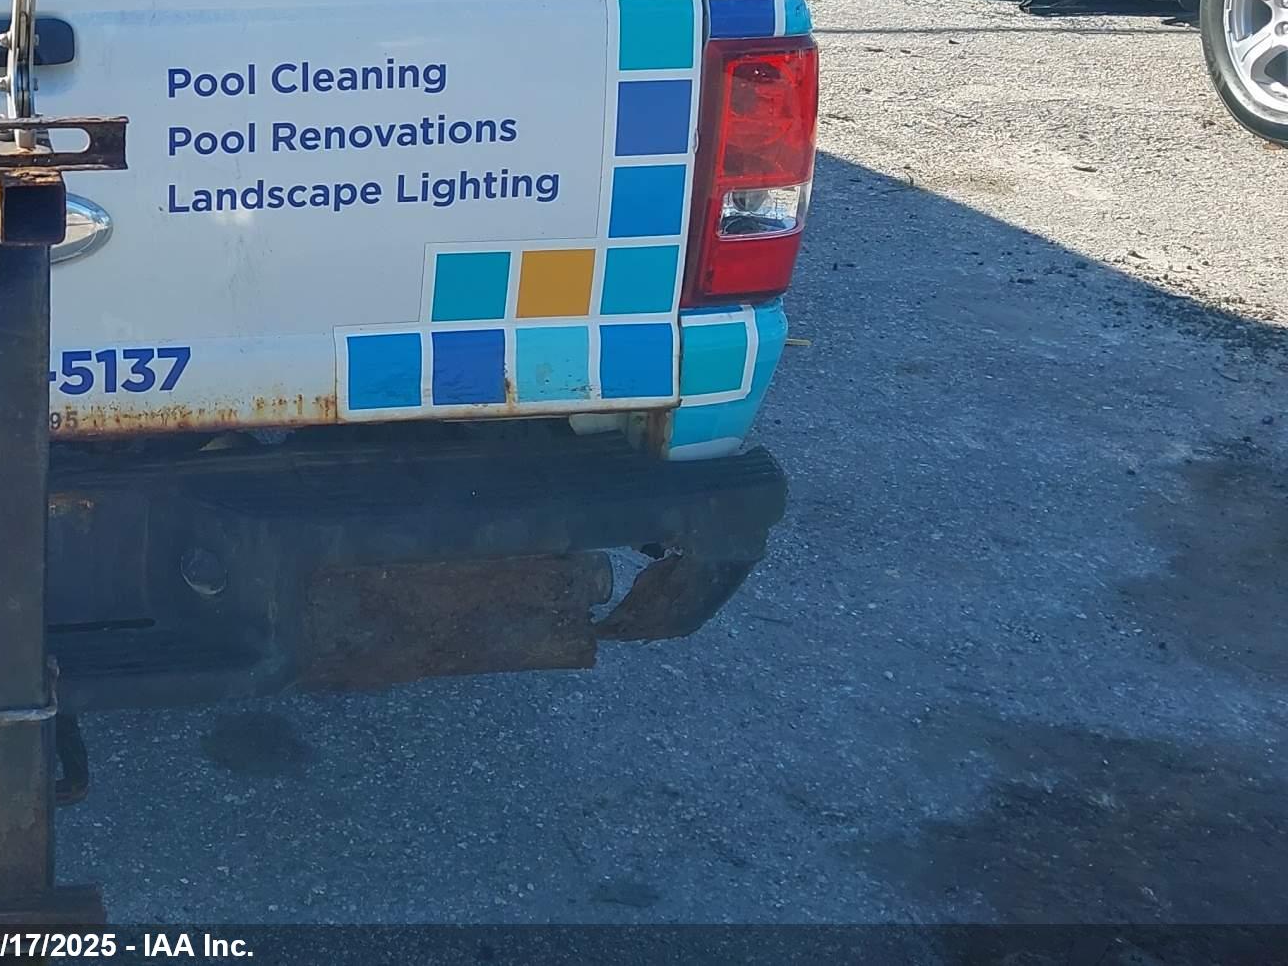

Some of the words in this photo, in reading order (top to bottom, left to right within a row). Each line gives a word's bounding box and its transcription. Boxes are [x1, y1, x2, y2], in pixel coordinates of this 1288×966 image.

[168, 63, 256, 98] Pool
[271, 57, 448, 94] Cleaning
[168, 122, 256, 157] Pool
[271, 115, 517, 152] Renovations
[168, 179, 382, 214] Landscape
[397, 169, 560, 208] Lighting
